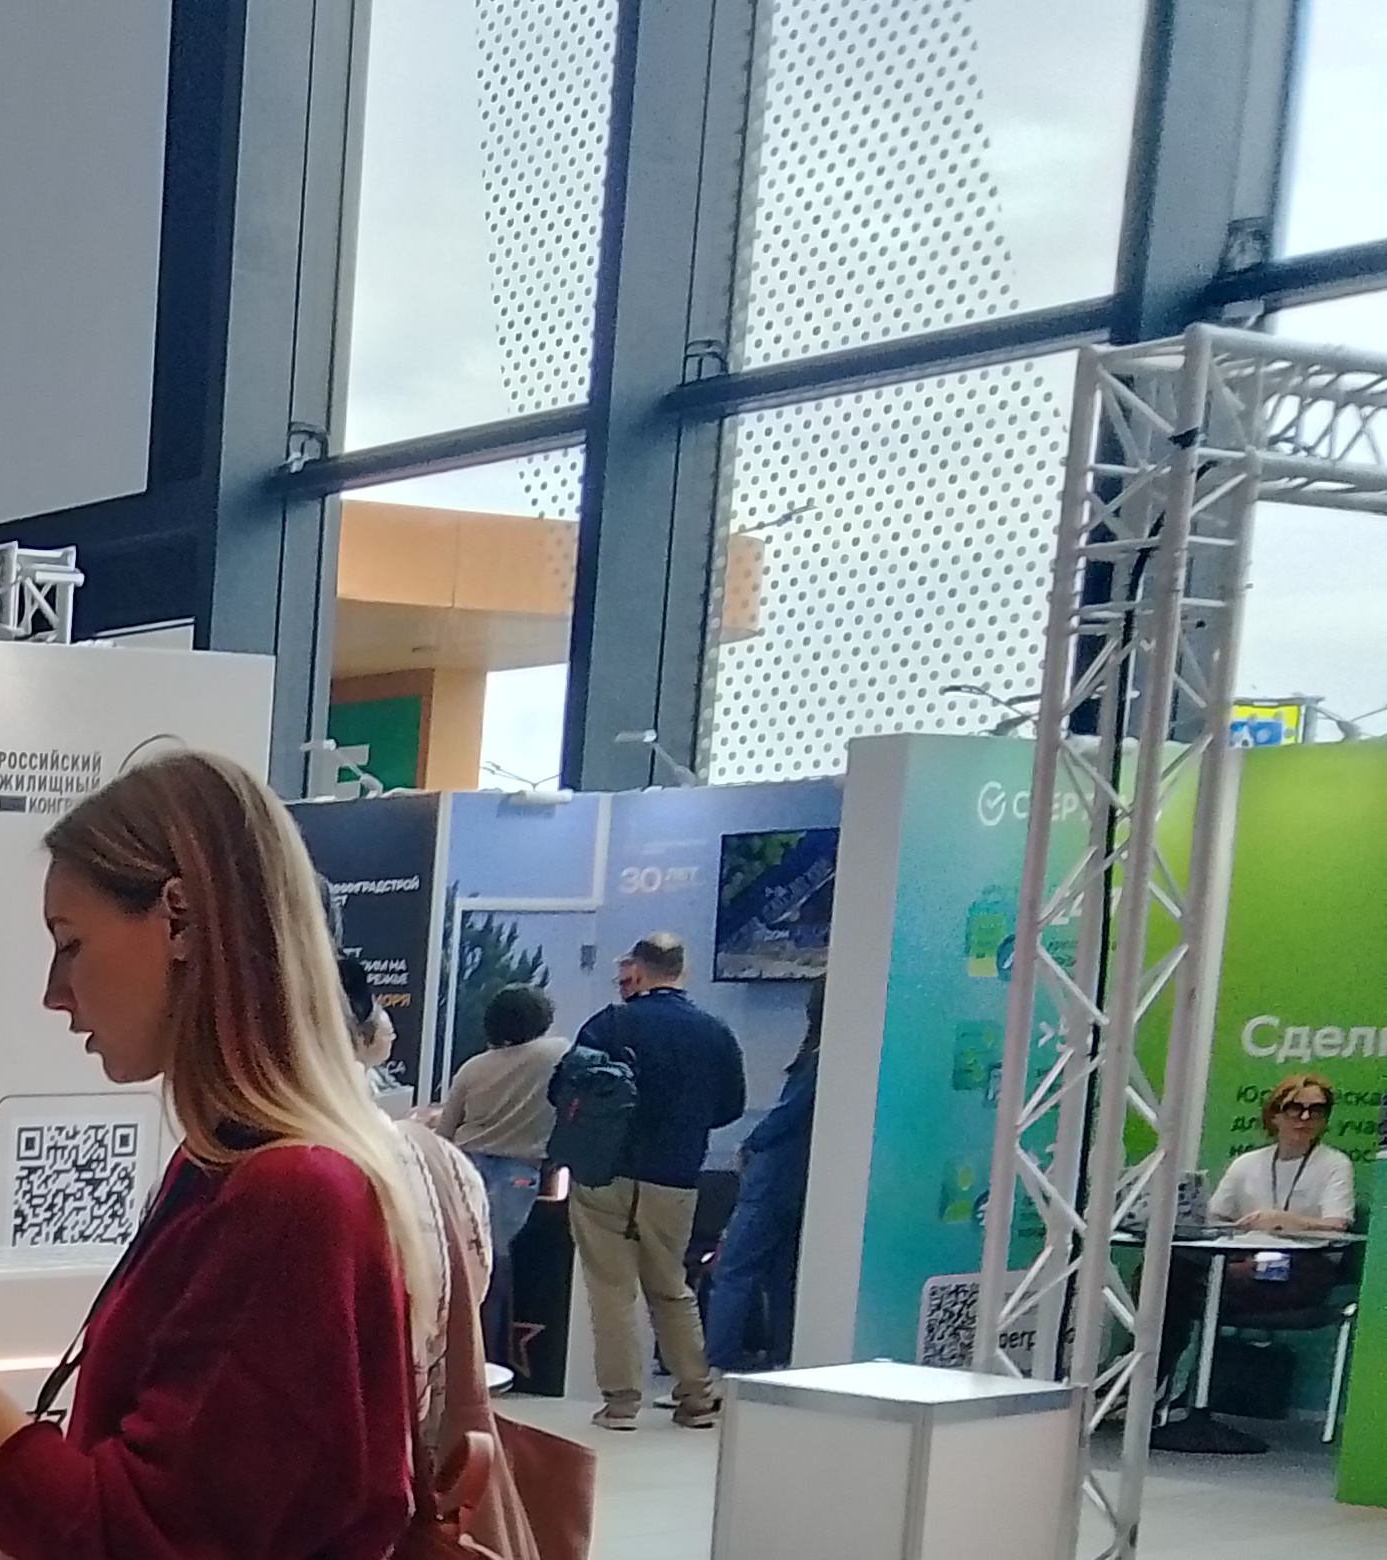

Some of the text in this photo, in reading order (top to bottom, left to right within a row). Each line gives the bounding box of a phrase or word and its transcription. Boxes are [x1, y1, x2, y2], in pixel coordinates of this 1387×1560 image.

[28, 795, 74, 815] КОНГР
[619, 866, 661, 893] 30
[1242, 1014, 1387, 1063] Сдел
